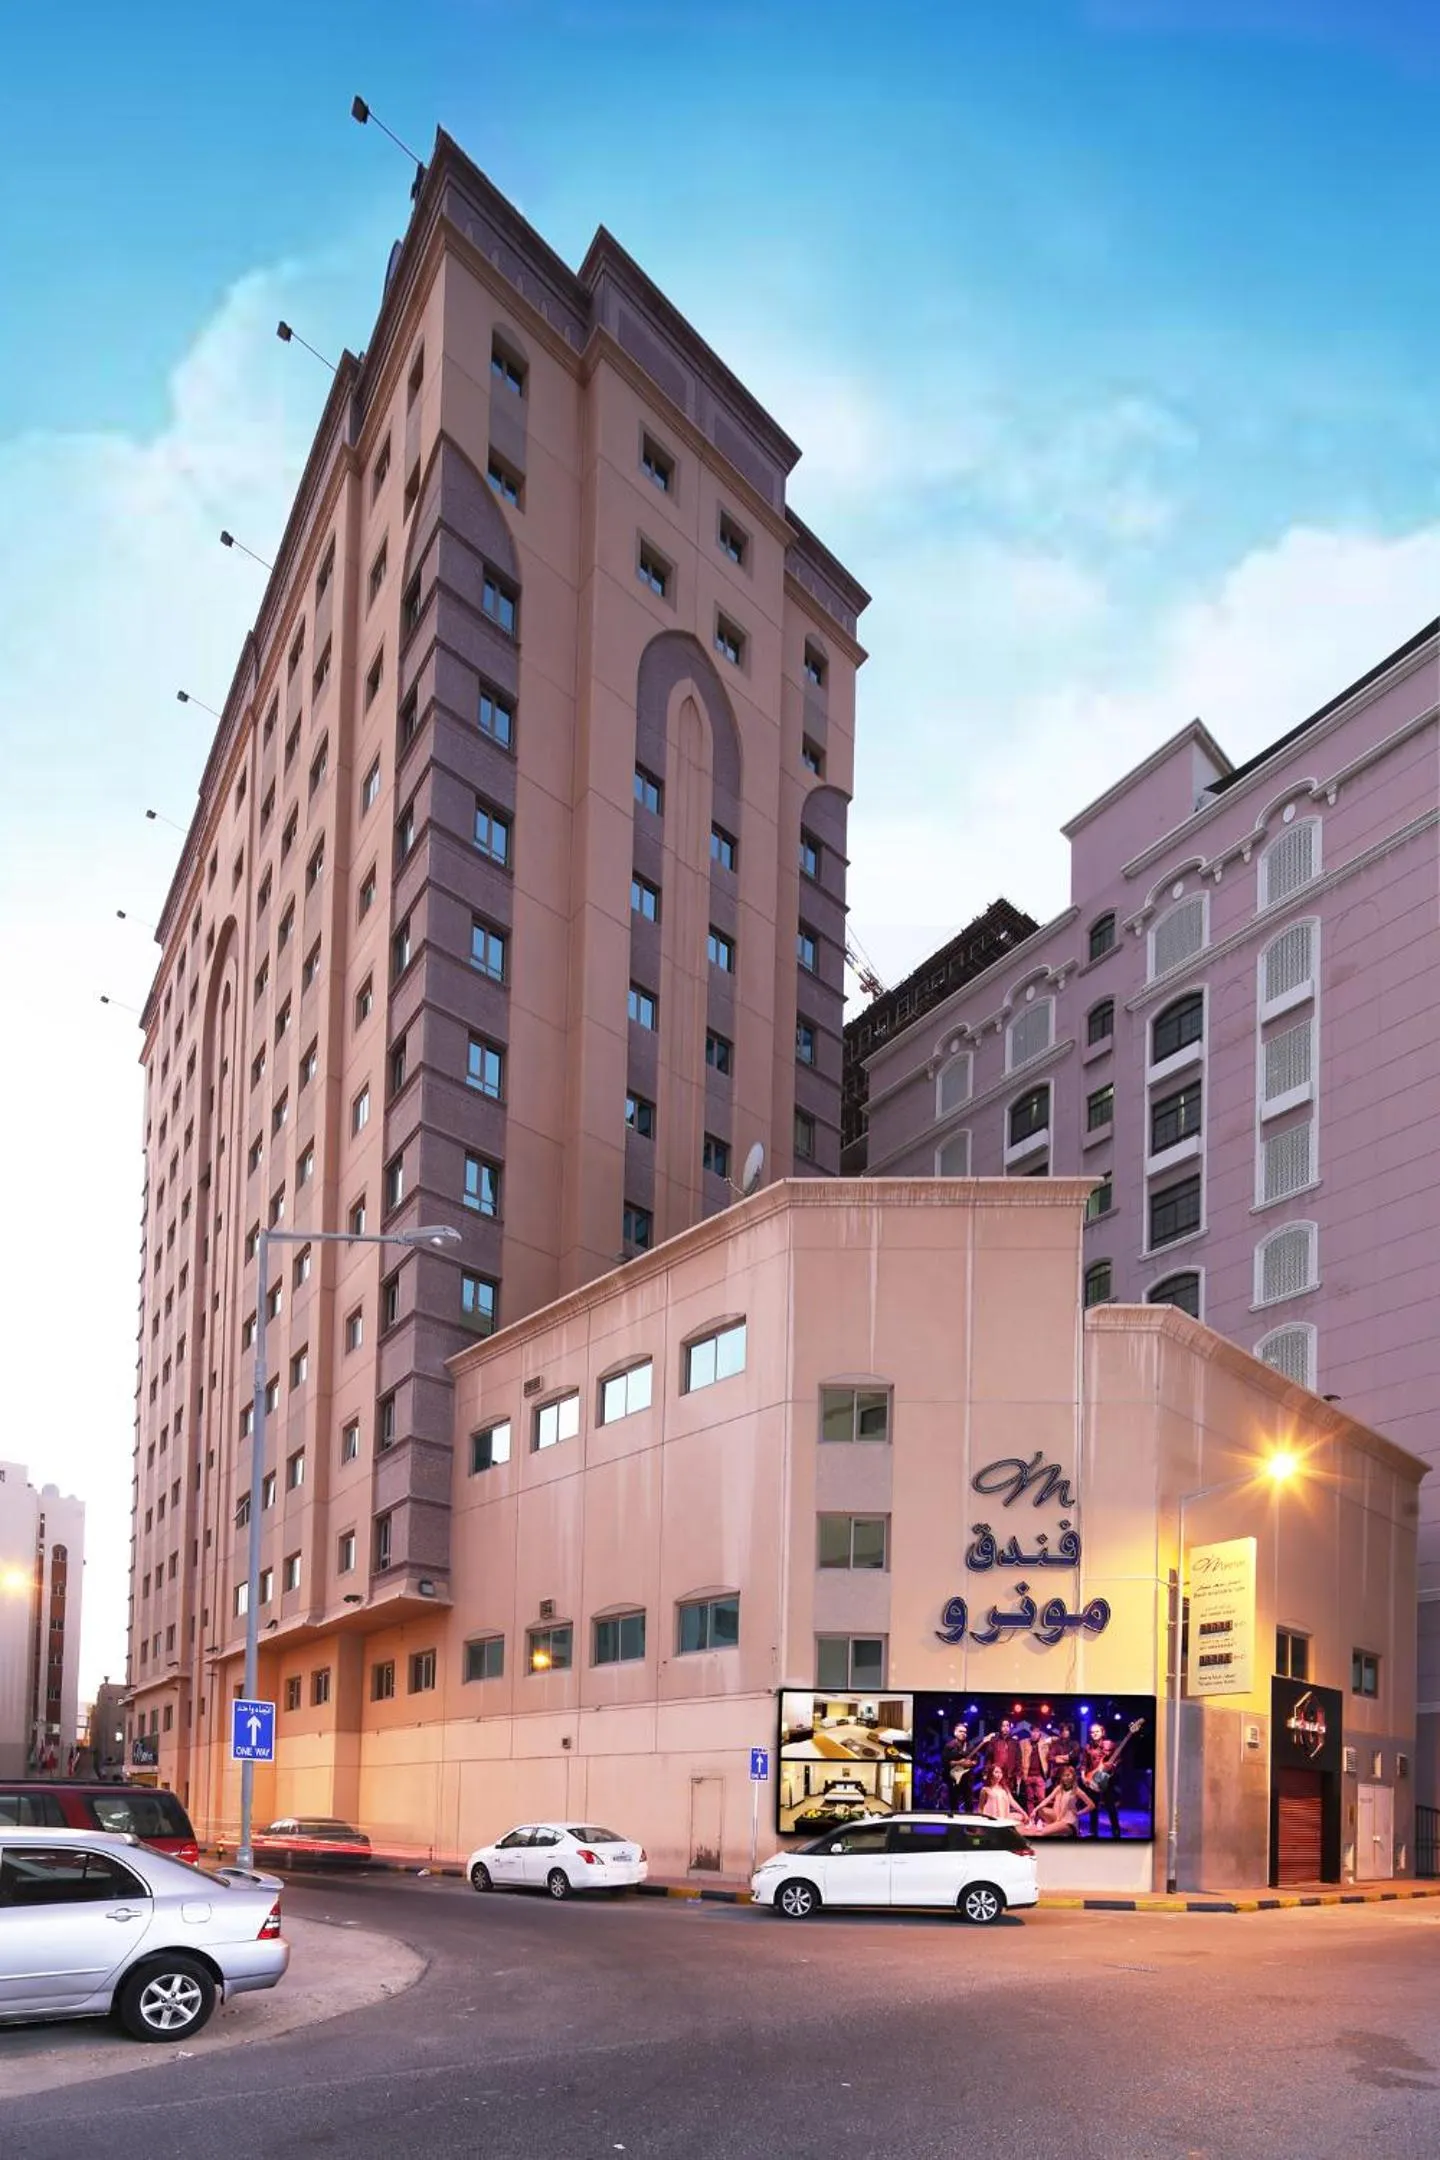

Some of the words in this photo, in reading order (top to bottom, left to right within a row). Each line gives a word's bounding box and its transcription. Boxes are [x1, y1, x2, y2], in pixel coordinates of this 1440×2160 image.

[966, 1519, 1081, 1572] فندق
[935, 1581, 1111, 1646] مونرو
[235, 1746, 253, 1757] ONE
[255, 1747, 271, 1757] WAY
